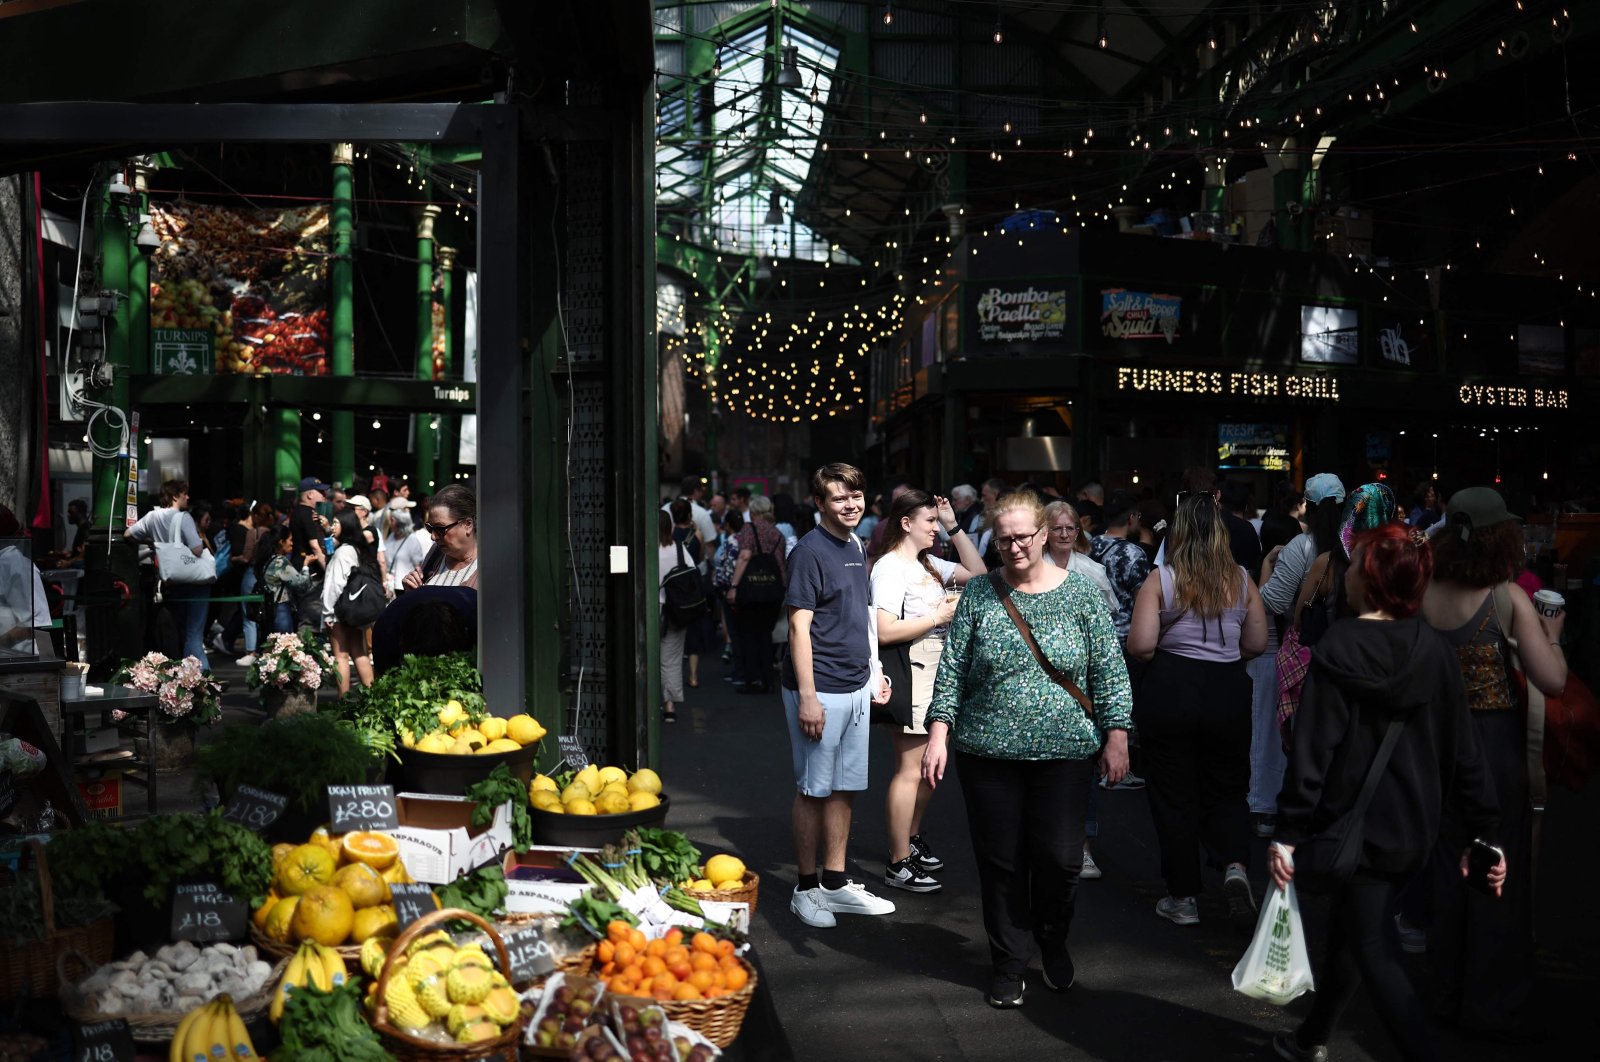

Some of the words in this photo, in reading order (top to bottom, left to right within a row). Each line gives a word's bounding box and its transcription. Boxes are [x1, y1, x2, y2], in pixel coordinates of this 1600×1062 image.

[988, 287, 1049, 306] Bomba
[985, 303, 1041, 323] Paella
[1109, 293, 1133, 312] Salt
[1133, 295, 1143, 310] &
[1143, 297, 1177, 319] Pepper
[1104, 311, 1157, 340] Squid
[154, 330, 209, 341] TURNIPS
[1118, 368, 1222, 394] FURNESS
[1228, 373, 1276, 397] FISH
[1285, 376, 1339, 400] GRILL
[433, 386, 470, 402] Turnips
[1459, 385, 1527, 407] OYSTER
[1534, 389, 1568, 409] BAR
[1220, 423, 1256, 437] FRESH
[327, 786, 357, 799] UGLY
[357, 785, 391, 797] FRUIT
[176, 883, 218, 895] DRIED
[192, 893, 234, 905] FIGS
[519, 891, 566, 907] ASPARAG
[178, 911, 222, 931] £18
